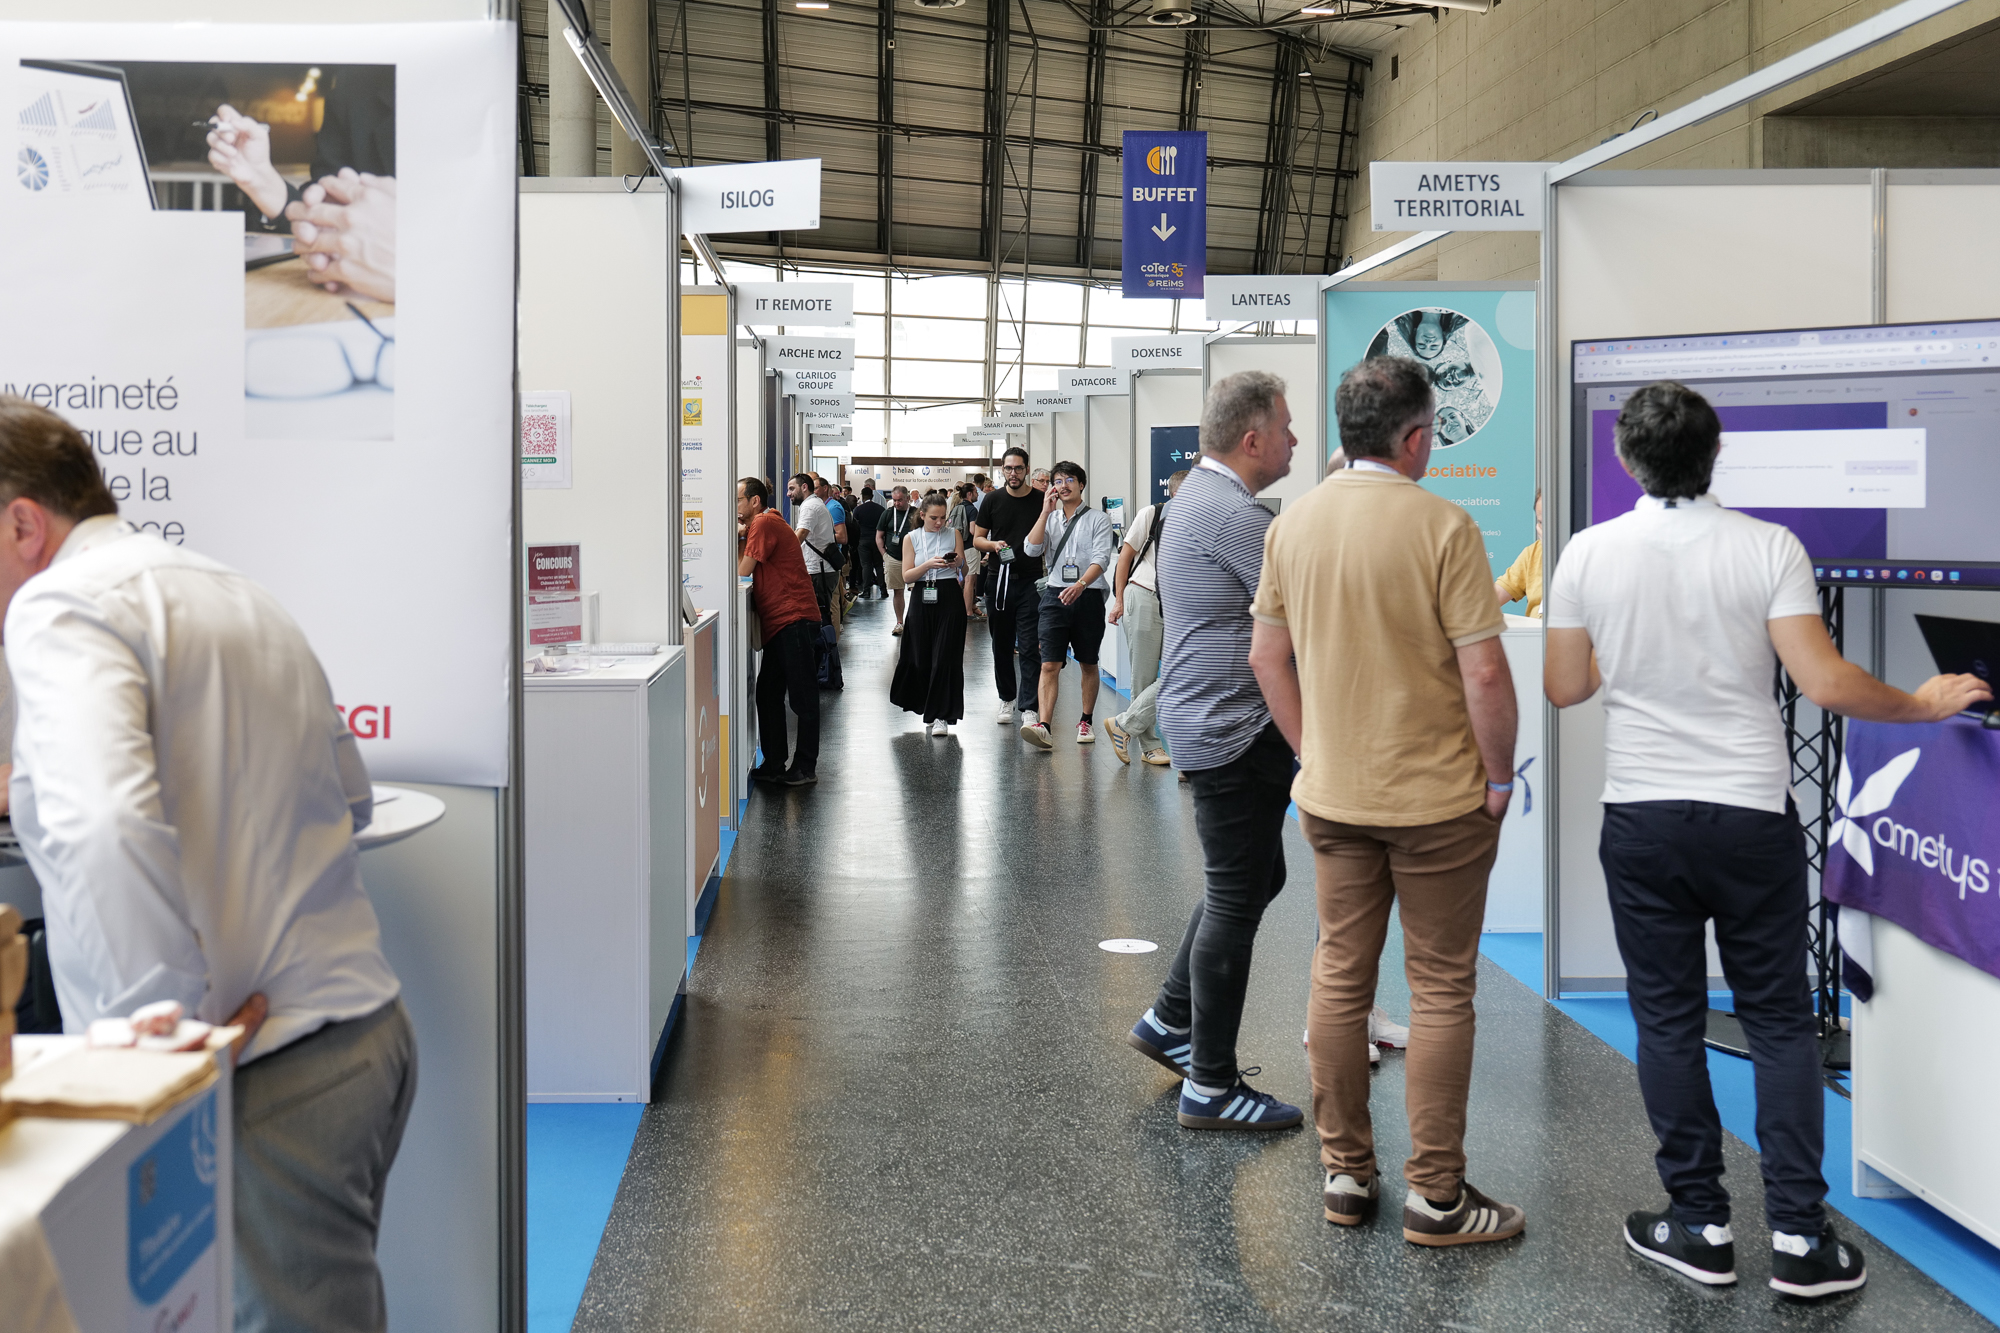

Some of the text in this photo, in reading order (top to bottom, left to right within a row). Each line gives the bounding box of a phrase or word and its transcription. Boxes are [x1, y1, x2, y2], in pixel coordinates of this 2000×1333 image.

[1417, 174, 1500, 192] AMETYS
[721, 189, 774, 209] ISILOG
[1132, 187, 1197, 202] BUFFET
[1394, 199, 1525, 217] TERRITORIAL
[756, 299, 832, 311] IT REMOTE
[1231, 293, 1291, 306] LANTEAS
[778, 348, 842, 360] ARCHE MC2
[1131, 347, 1183, 358] DOXENSE
[795, 371, 837, 380] CLARILOG
[798, 381, 834, 390] GROUPE
[1071, 378, 1117, 387] DATACORE
[4, 375, 178, 411] veraineté
[809, 398, 840, 406] SOPHOS
[1036, 397, 1072, 405] HORANET
[153, 430, 197, 456] au
[142, 467, 171, 501] la
[536, 557, 573, 570] CONCOURS
[335, 704, 391, 740] GI
[1872, 816, 1990, 900] ametys
